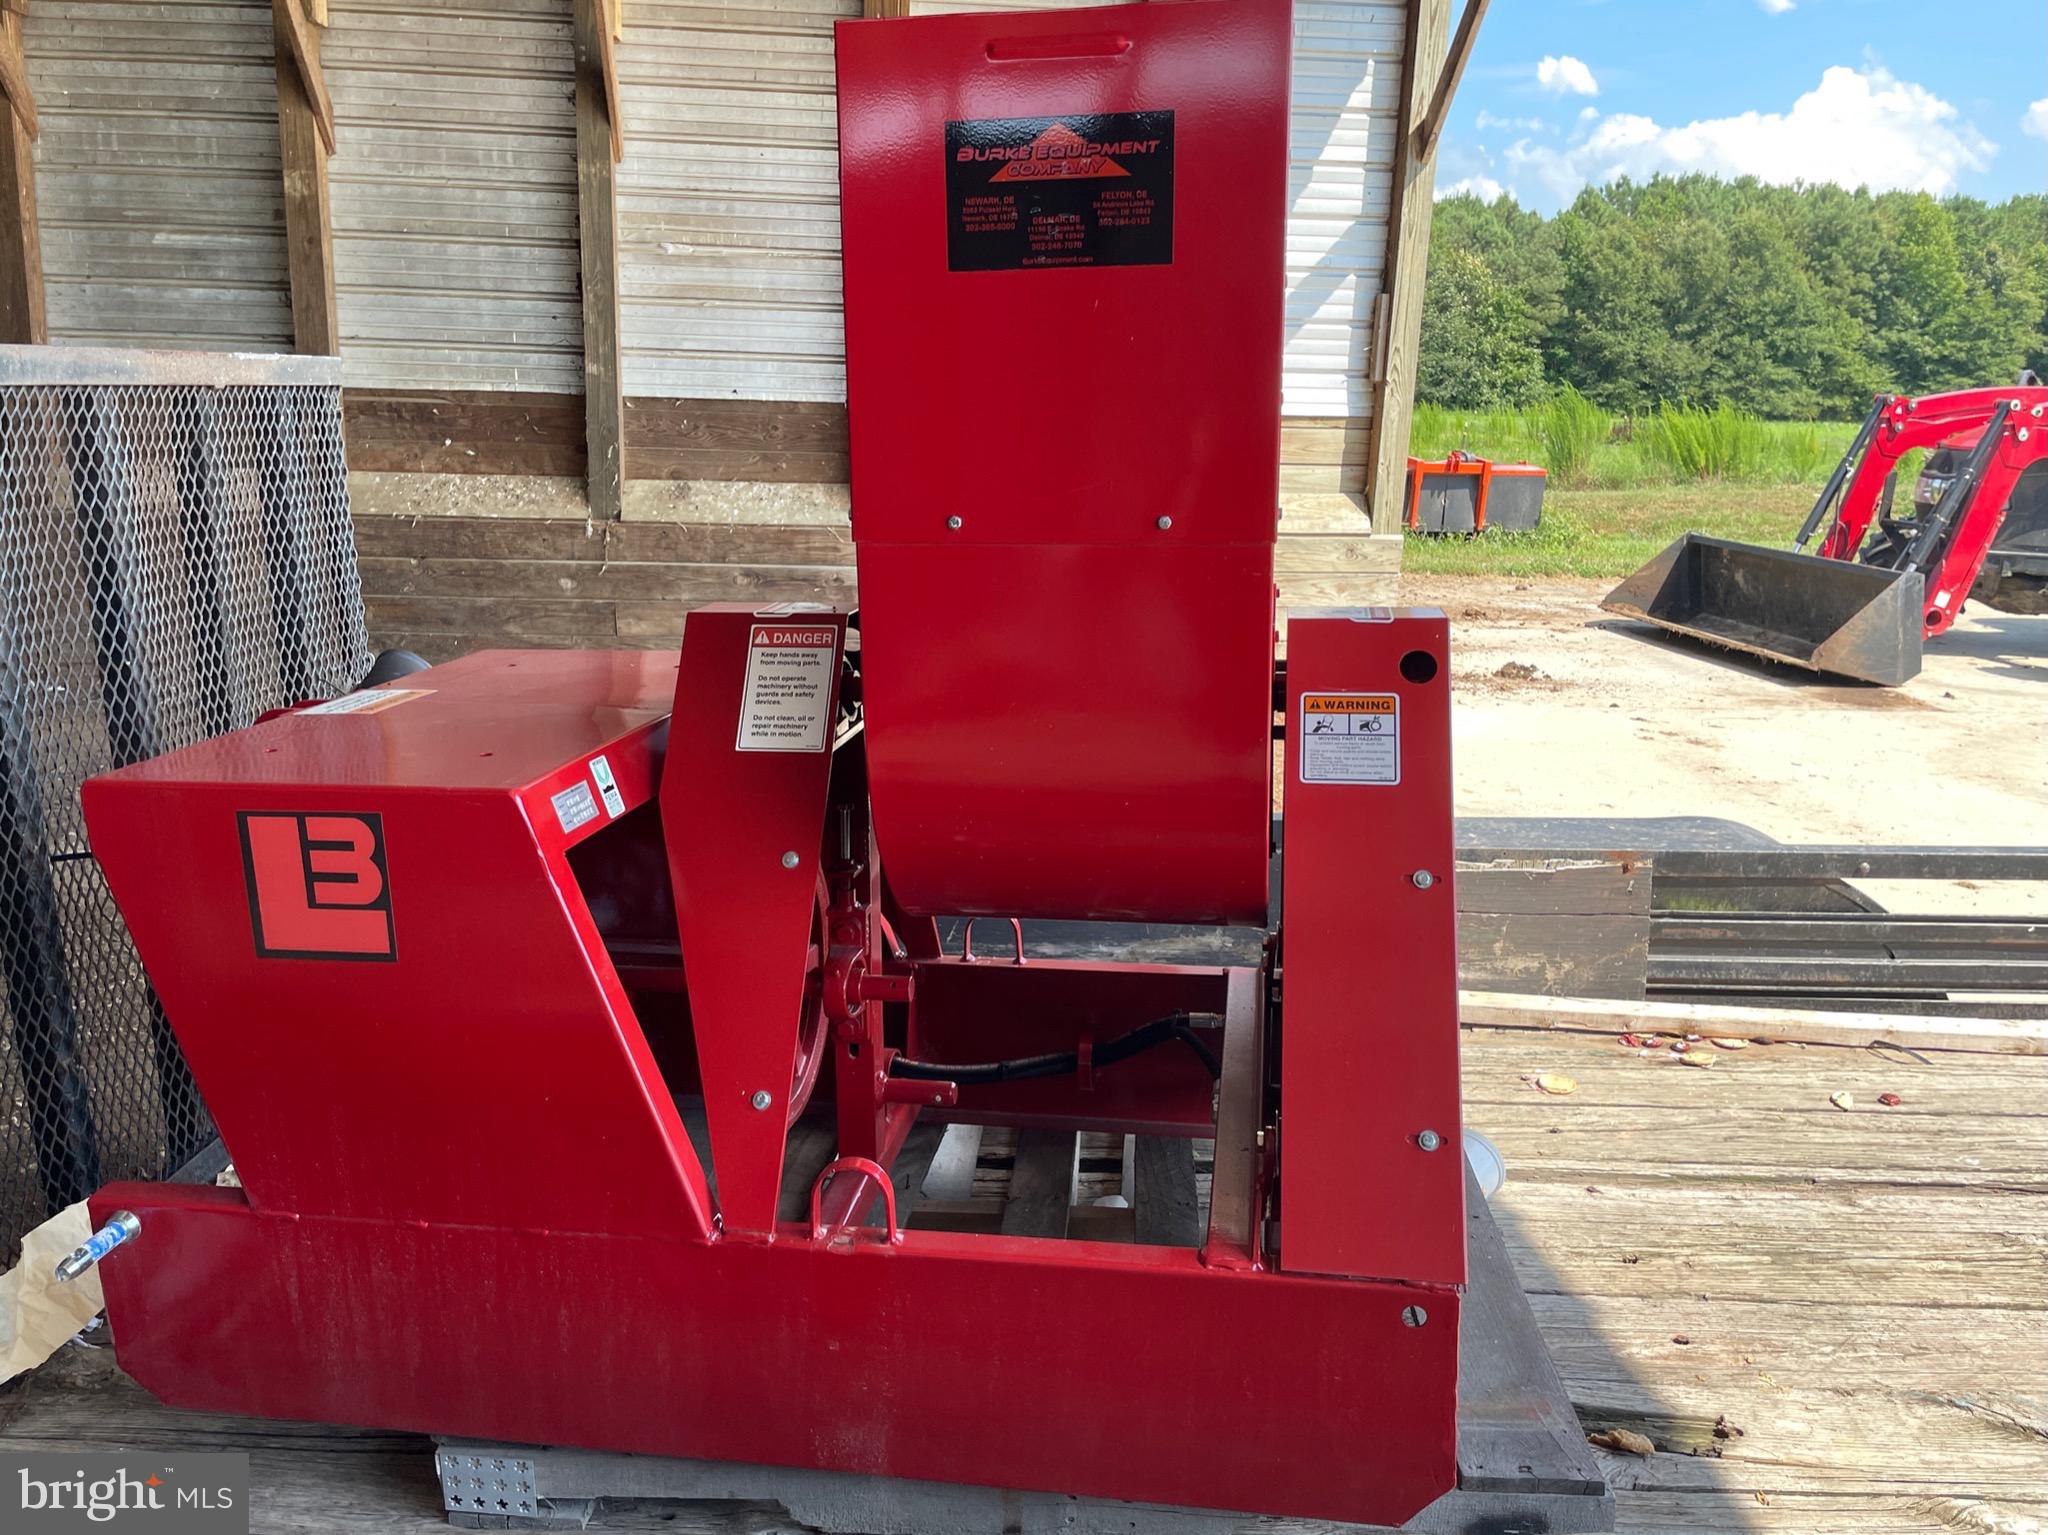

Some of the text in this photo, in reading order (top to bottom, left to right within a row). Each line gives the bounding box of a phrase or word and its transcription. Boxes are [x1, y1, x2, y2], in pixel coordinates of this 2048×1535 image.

[957, 140, 1160, 162] BURKE EQUIPMENT
[1008, 158, 1106, 177] COMPANY
[773, 632, 832, 645] DANGER
[779, 651, 800, 659] hands
[801, 652, 818, 660] away
[776, 659, 802, 667] moving
[802, 660, 821, 668] parts.
[781, 675, 807, 683] operate
[756, 683, 792, 691] machinery
[755, 691, 779, 699] guards
[794, 691, 815, 700] safety
[755, 698, 782, 706] devices.
[1324, 701, 1391, 710] WARNING
[751, 723, 808, 732] repair machinery
